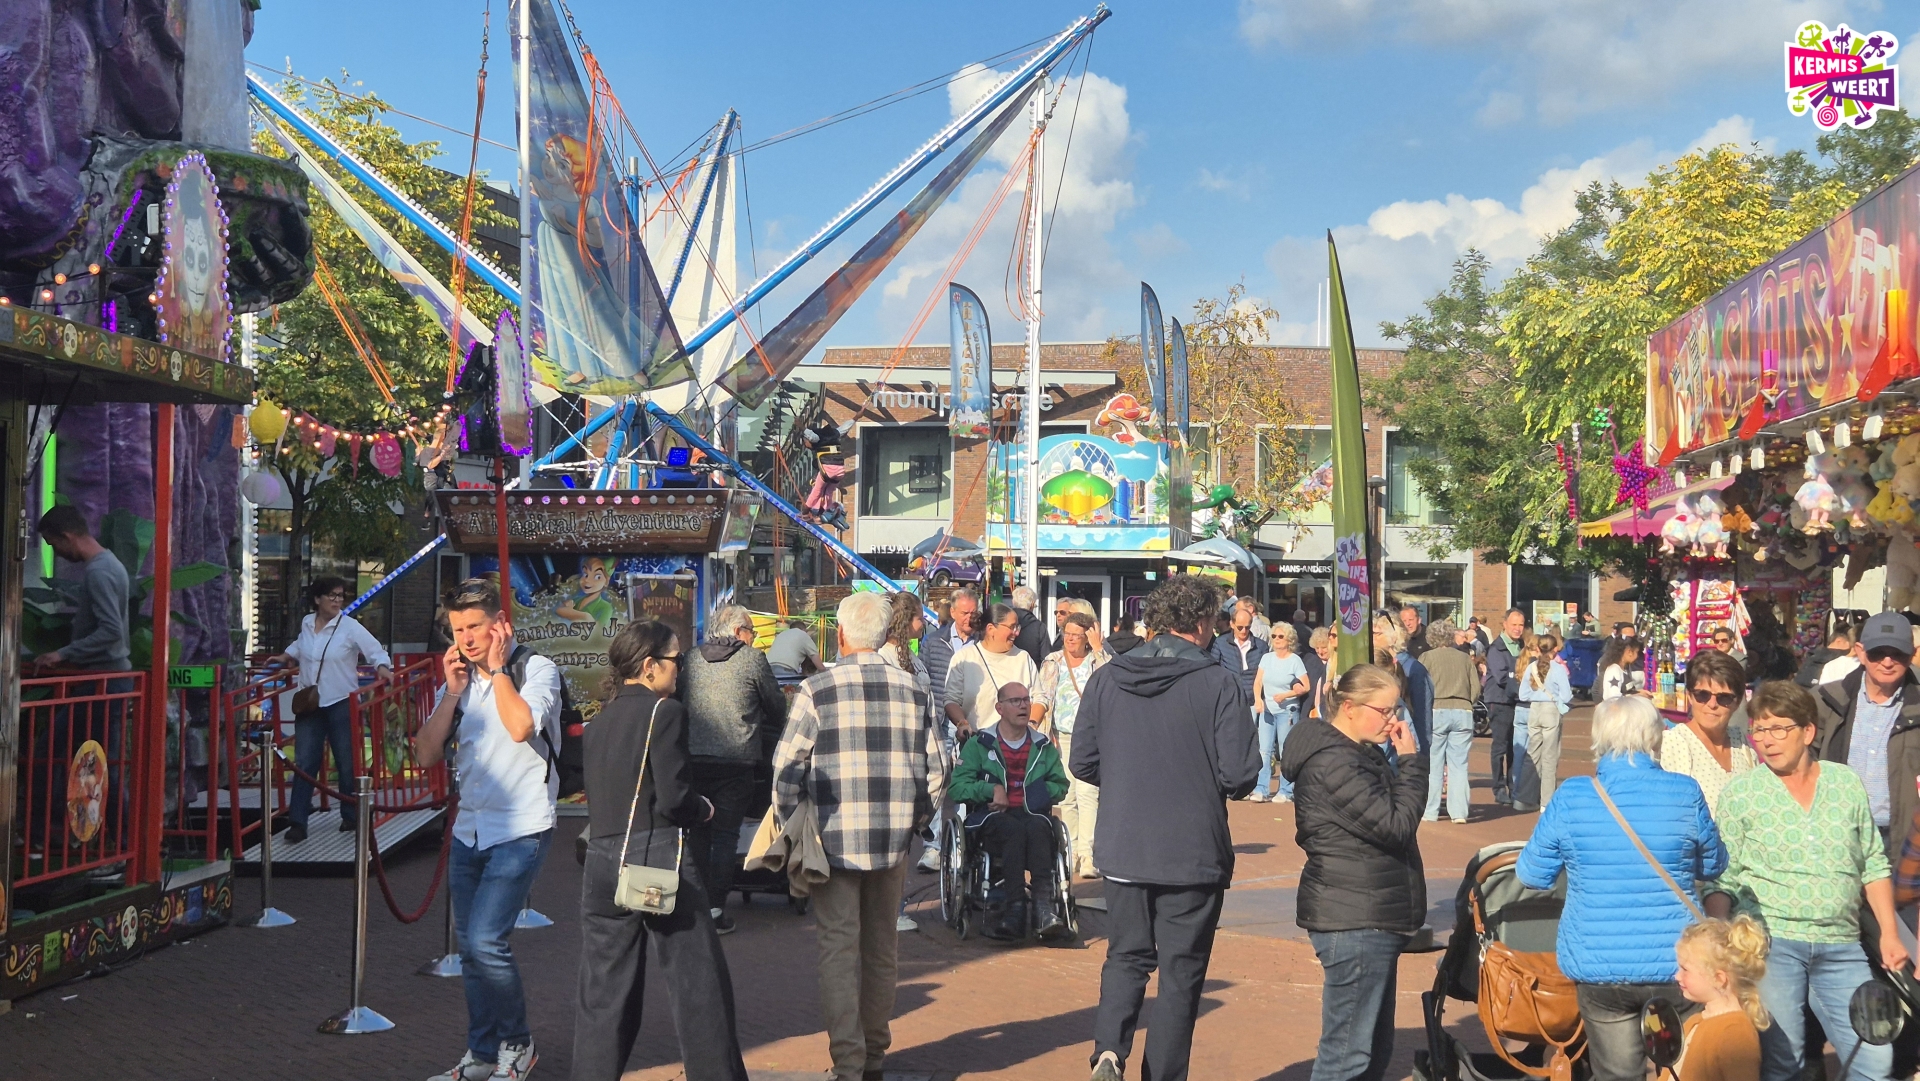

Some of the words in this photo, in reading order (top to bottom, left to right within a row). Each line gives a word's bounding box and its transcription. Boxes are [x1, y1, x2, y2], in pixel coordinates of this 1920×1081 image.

[1720, 253, 1832, 431] SLOTS
[467, 512, 485, 535] A
[584, 508, 703, 533] Adventure
[870, 544, 912, 553] RITUAL
[513, 621, 596, 643] antasy
[168, 669, 192, 685] ANG
